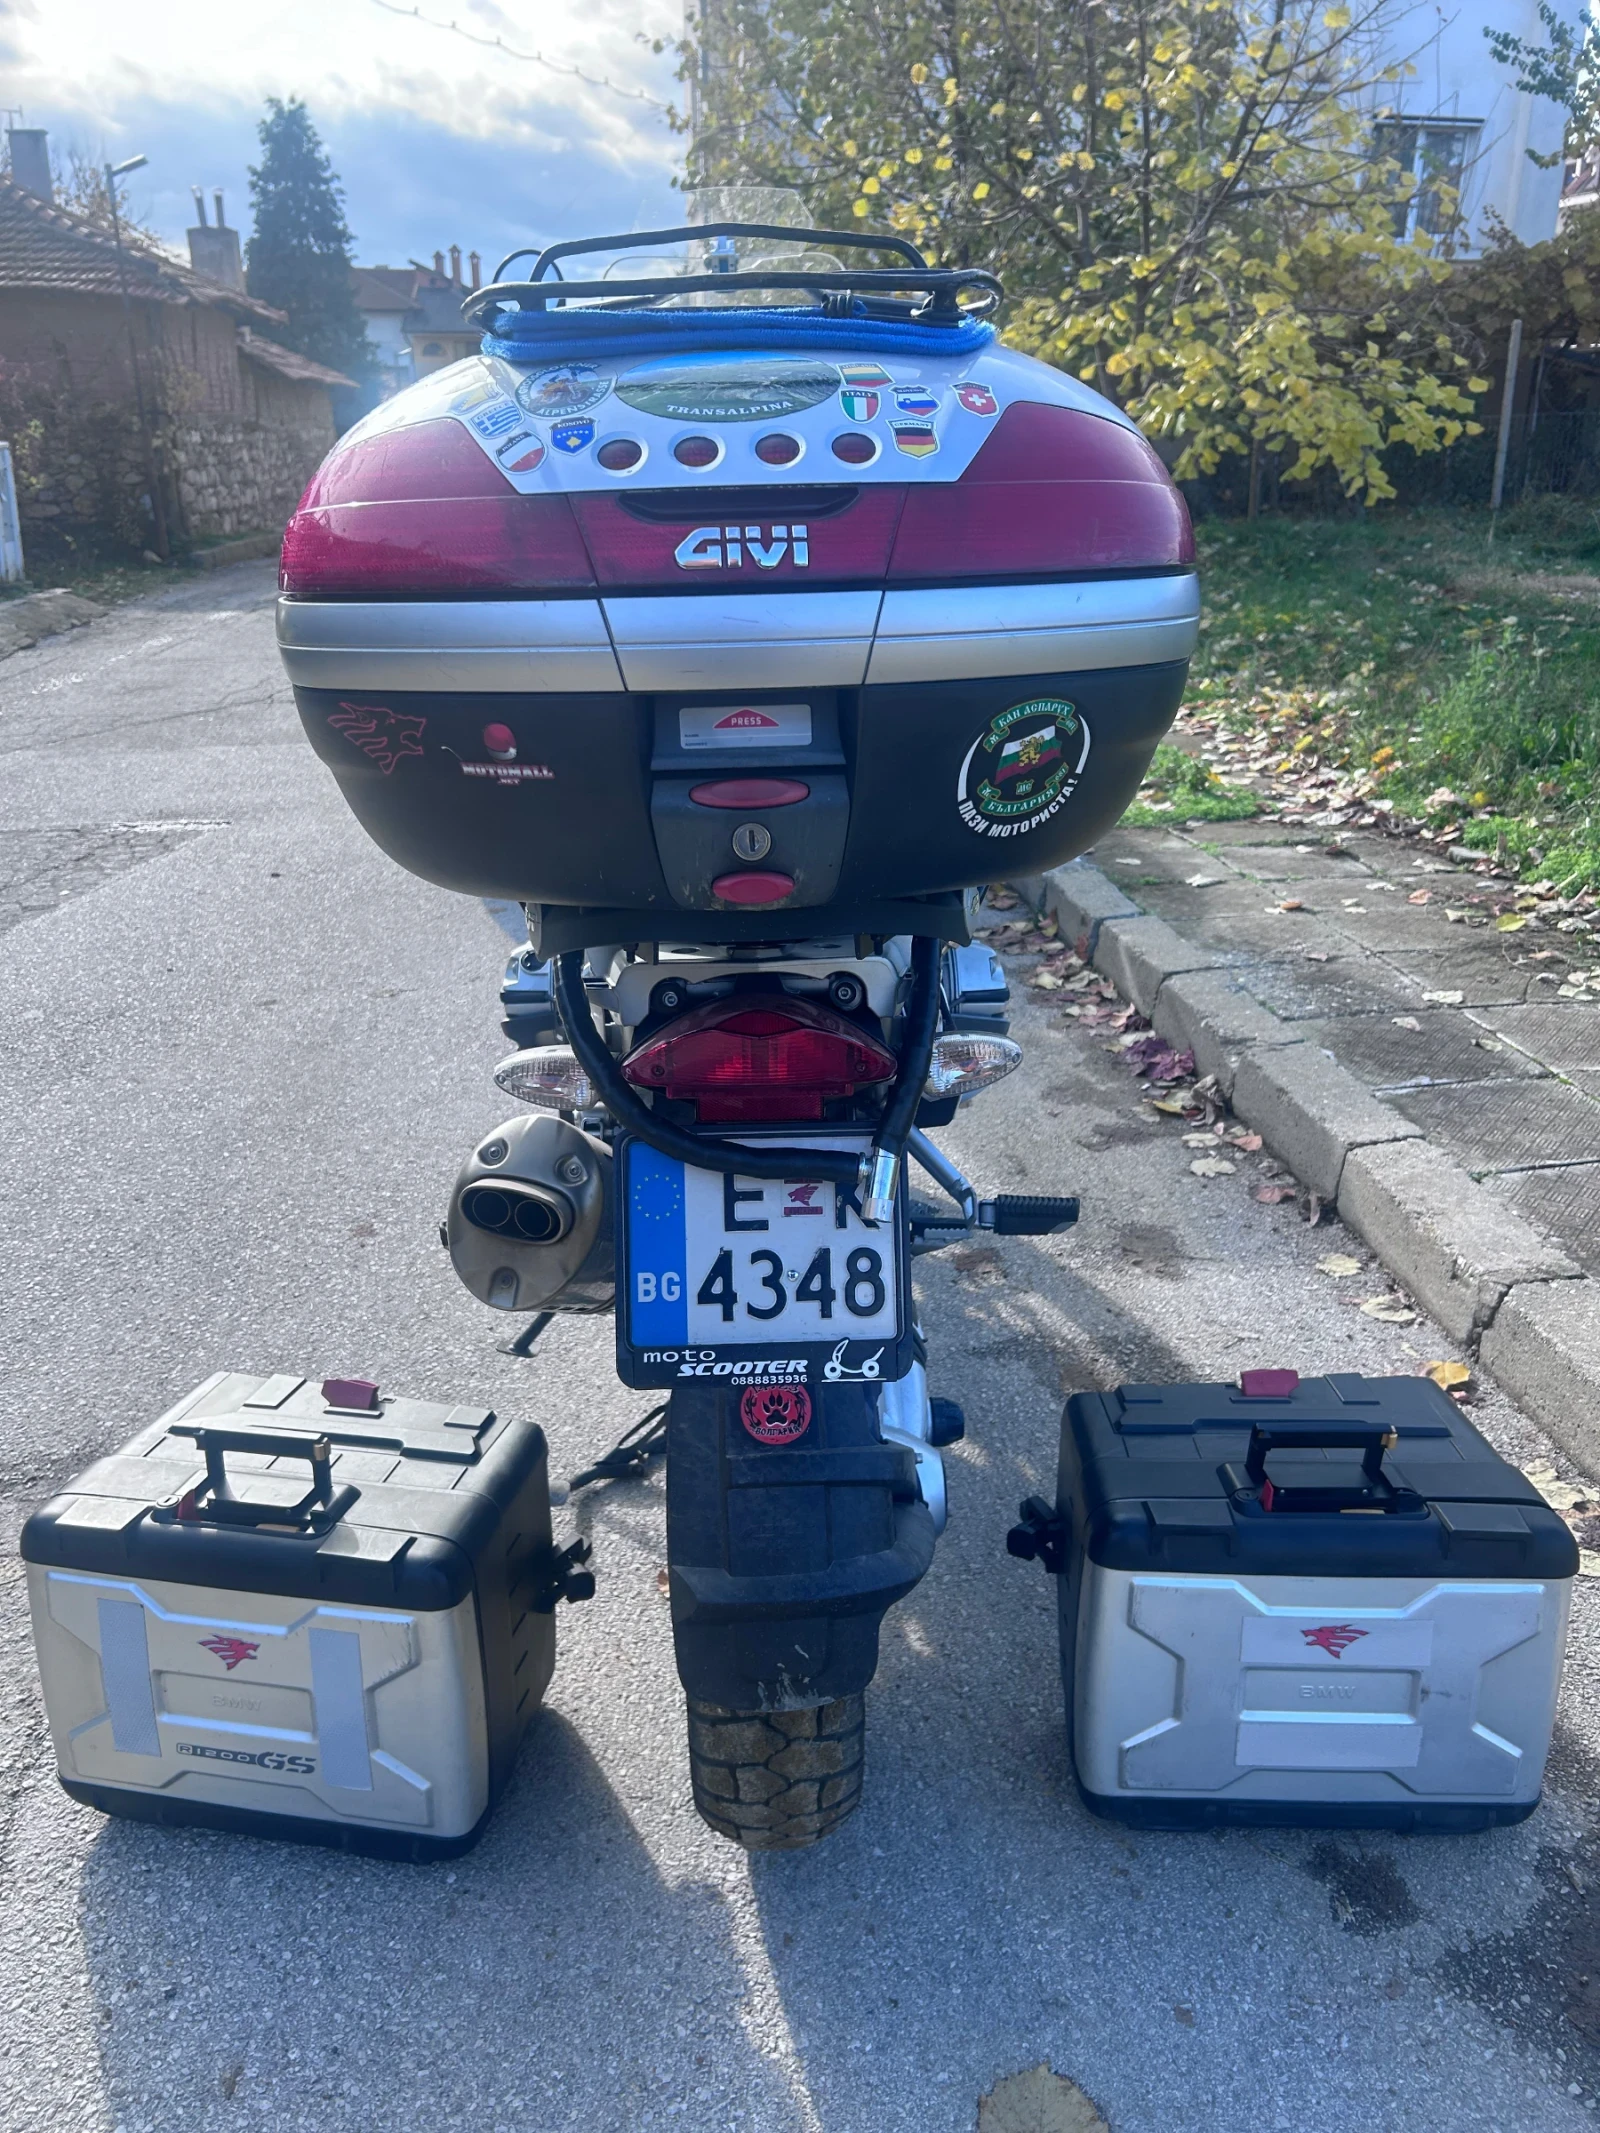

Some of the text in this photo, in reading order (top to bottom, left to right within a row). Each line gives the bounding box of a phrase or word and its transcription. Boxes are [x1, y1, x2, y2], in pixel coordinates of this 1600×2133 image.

[536, 380, 610, 416] ALPENSTRASSE
[666, 400, 794, 416] TRANSALPINA
[557, 418, 590, 429] KOSOVO
[502, 434, 525, 452] POLAND
[674, 525, 809, 569] GIVI
[731, 717, 762, 726] PRESS
[998, 708, 1021, 728] КАН
[958, 778, 1078, 837] ПАЗИ МОТОРИСТА!
[987, 788, 1054, 813] БЪЛГАРИЯ
[724, 1173, 769, 1232] E
[637, 1271, 681, 1303] BG
[697, 1247, 886, 1322] 4348
[643, 1349, 716, 1363] moto
[677, 1359, 808, 1377] SCOOTER
[731, 1374, 808, 1386] 0888835936
[1300, 1685, 1356, 1699] BMW
[212, 1694, 262, 1711] BMW
